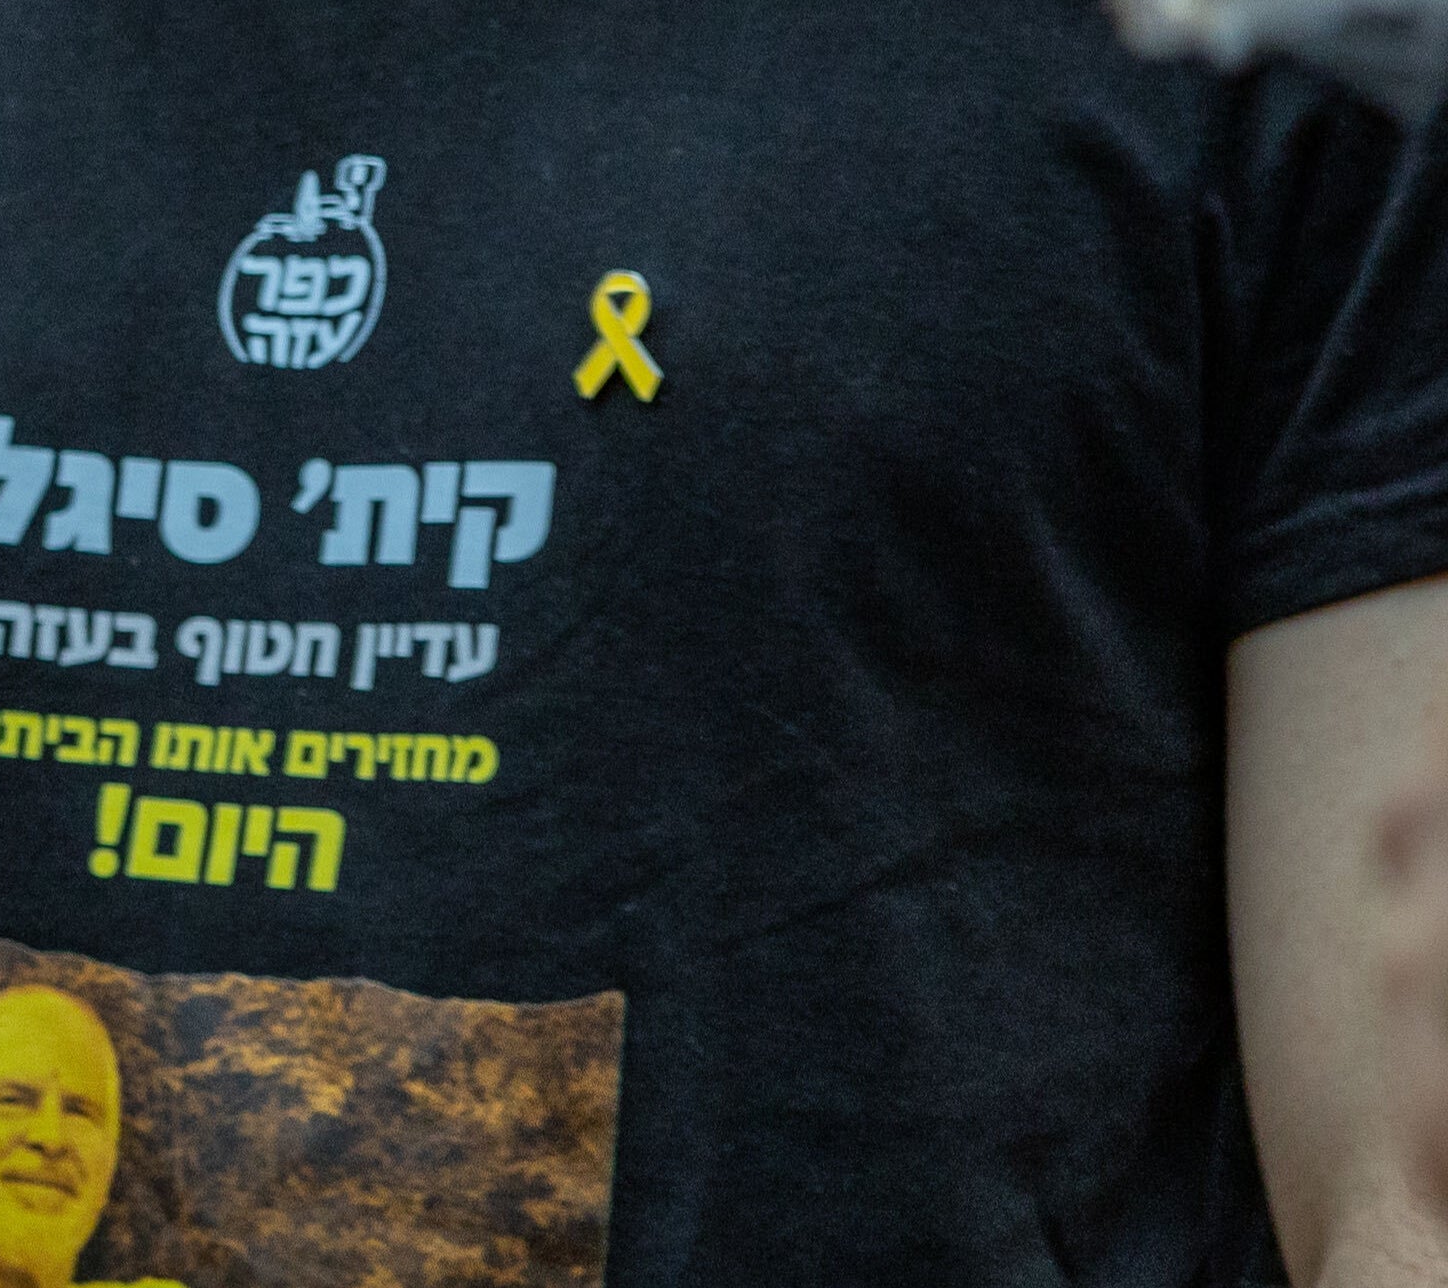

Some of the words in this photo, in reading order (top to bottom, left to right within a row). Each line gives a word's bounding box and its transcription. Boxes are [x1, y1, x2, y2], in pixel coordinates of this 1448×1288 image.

[238, 254, 371, 317] כפר
[241, 310, 363, 370] עזה
[176, 613, 341, 687] חטוף
[348, 619, 500, 691] עדיין
[149, 720, 276, 778] אותו
[283, 727, 500, 785] מחזירים
[88, 783, 346, 893] היום!
